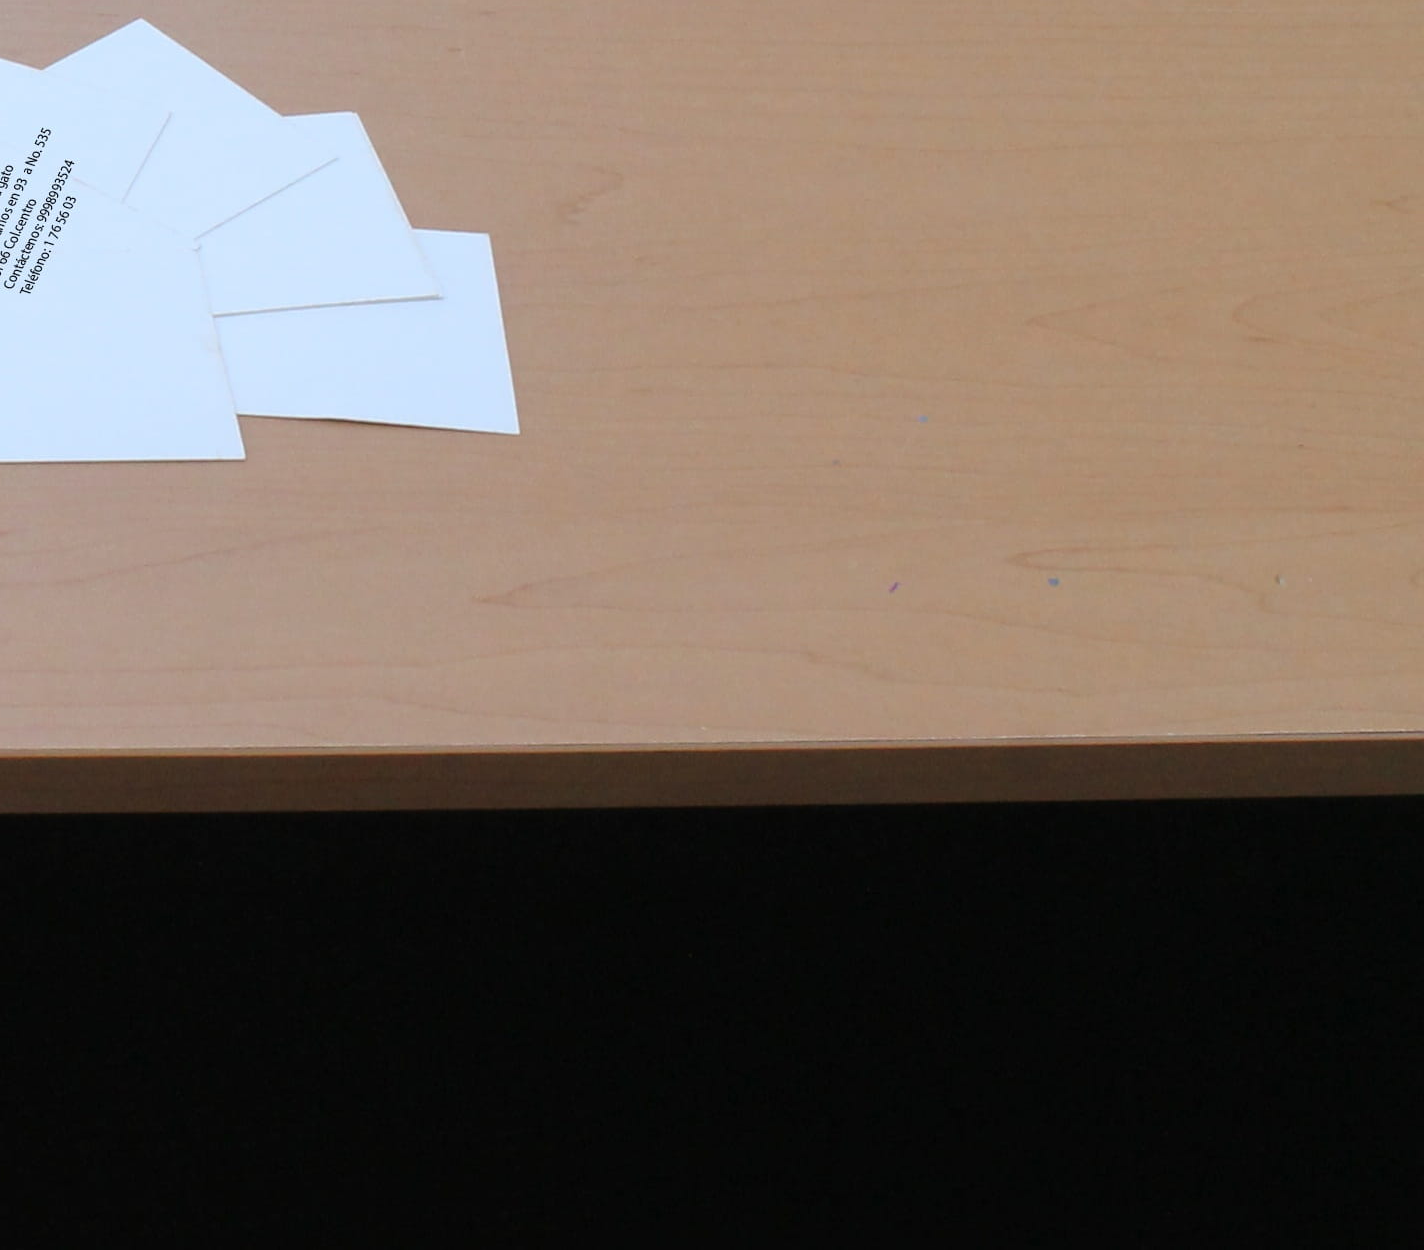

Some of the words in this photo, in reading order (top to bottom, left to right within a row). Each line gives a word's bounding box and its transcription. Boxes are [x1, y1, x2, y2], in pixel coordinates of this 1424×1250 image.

[34, 127, 52, 149] 535
[25, 149, 43, 167] No.
[23, 166, 33, 176] a
[13, 177, 28, 192] 93
[8, 192, 21, 207] en
[62, 195, 77, 210] 03
[3, 224, 45, 289] Contáctenos:
[36, 159, 75, 223] 9998993524
[55, 210, 70, 226] 56
[48, 224, 62, 240] 76
[43, 239, 55, 247] 1
[19, 249, 52, 295] Teléfono:
